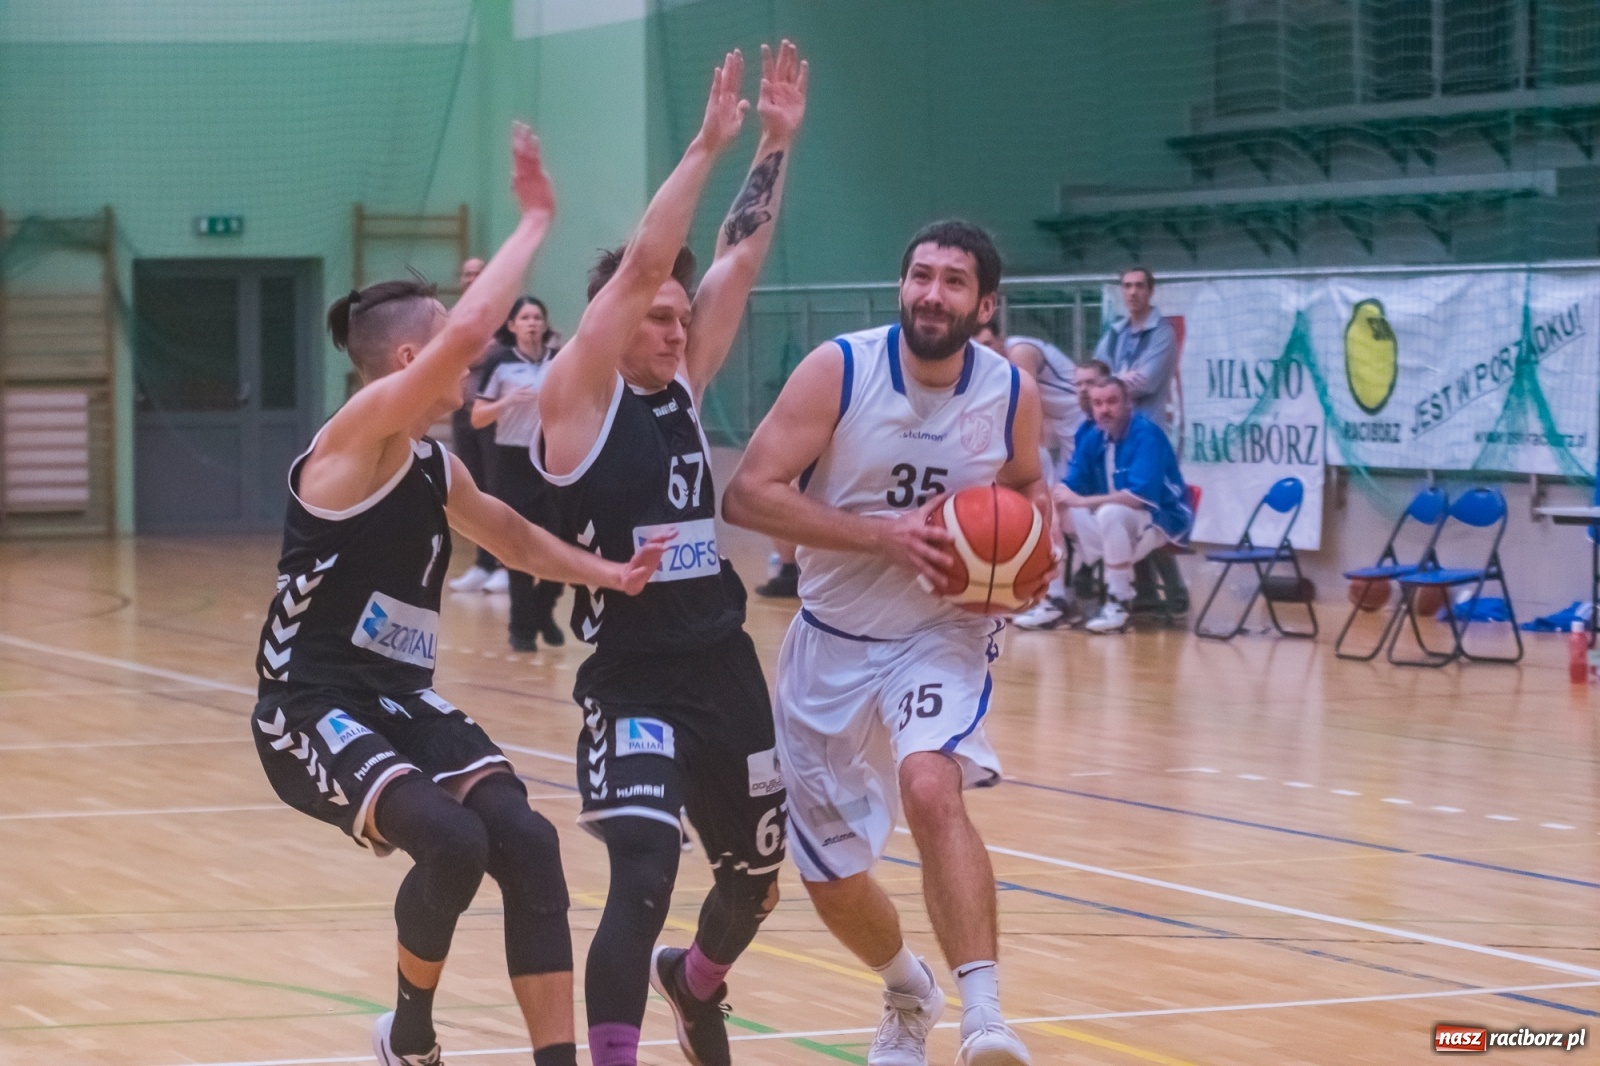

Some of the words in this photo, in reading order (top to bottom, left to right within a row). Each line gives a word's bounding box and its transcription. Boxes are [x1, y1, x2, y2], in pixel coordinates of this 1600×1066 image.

[1206, 358, 1303, 400] MIASTO
[1192, 412, 1318, 465] RACIBÓRZ
[668, 452, 704, 510] 67
[886, 463, 949, 508] 35
[669, 540, 717, 571] ZOFS
[898, 683, 943, 732] 35
[616, 783, 665, 799] hummel
